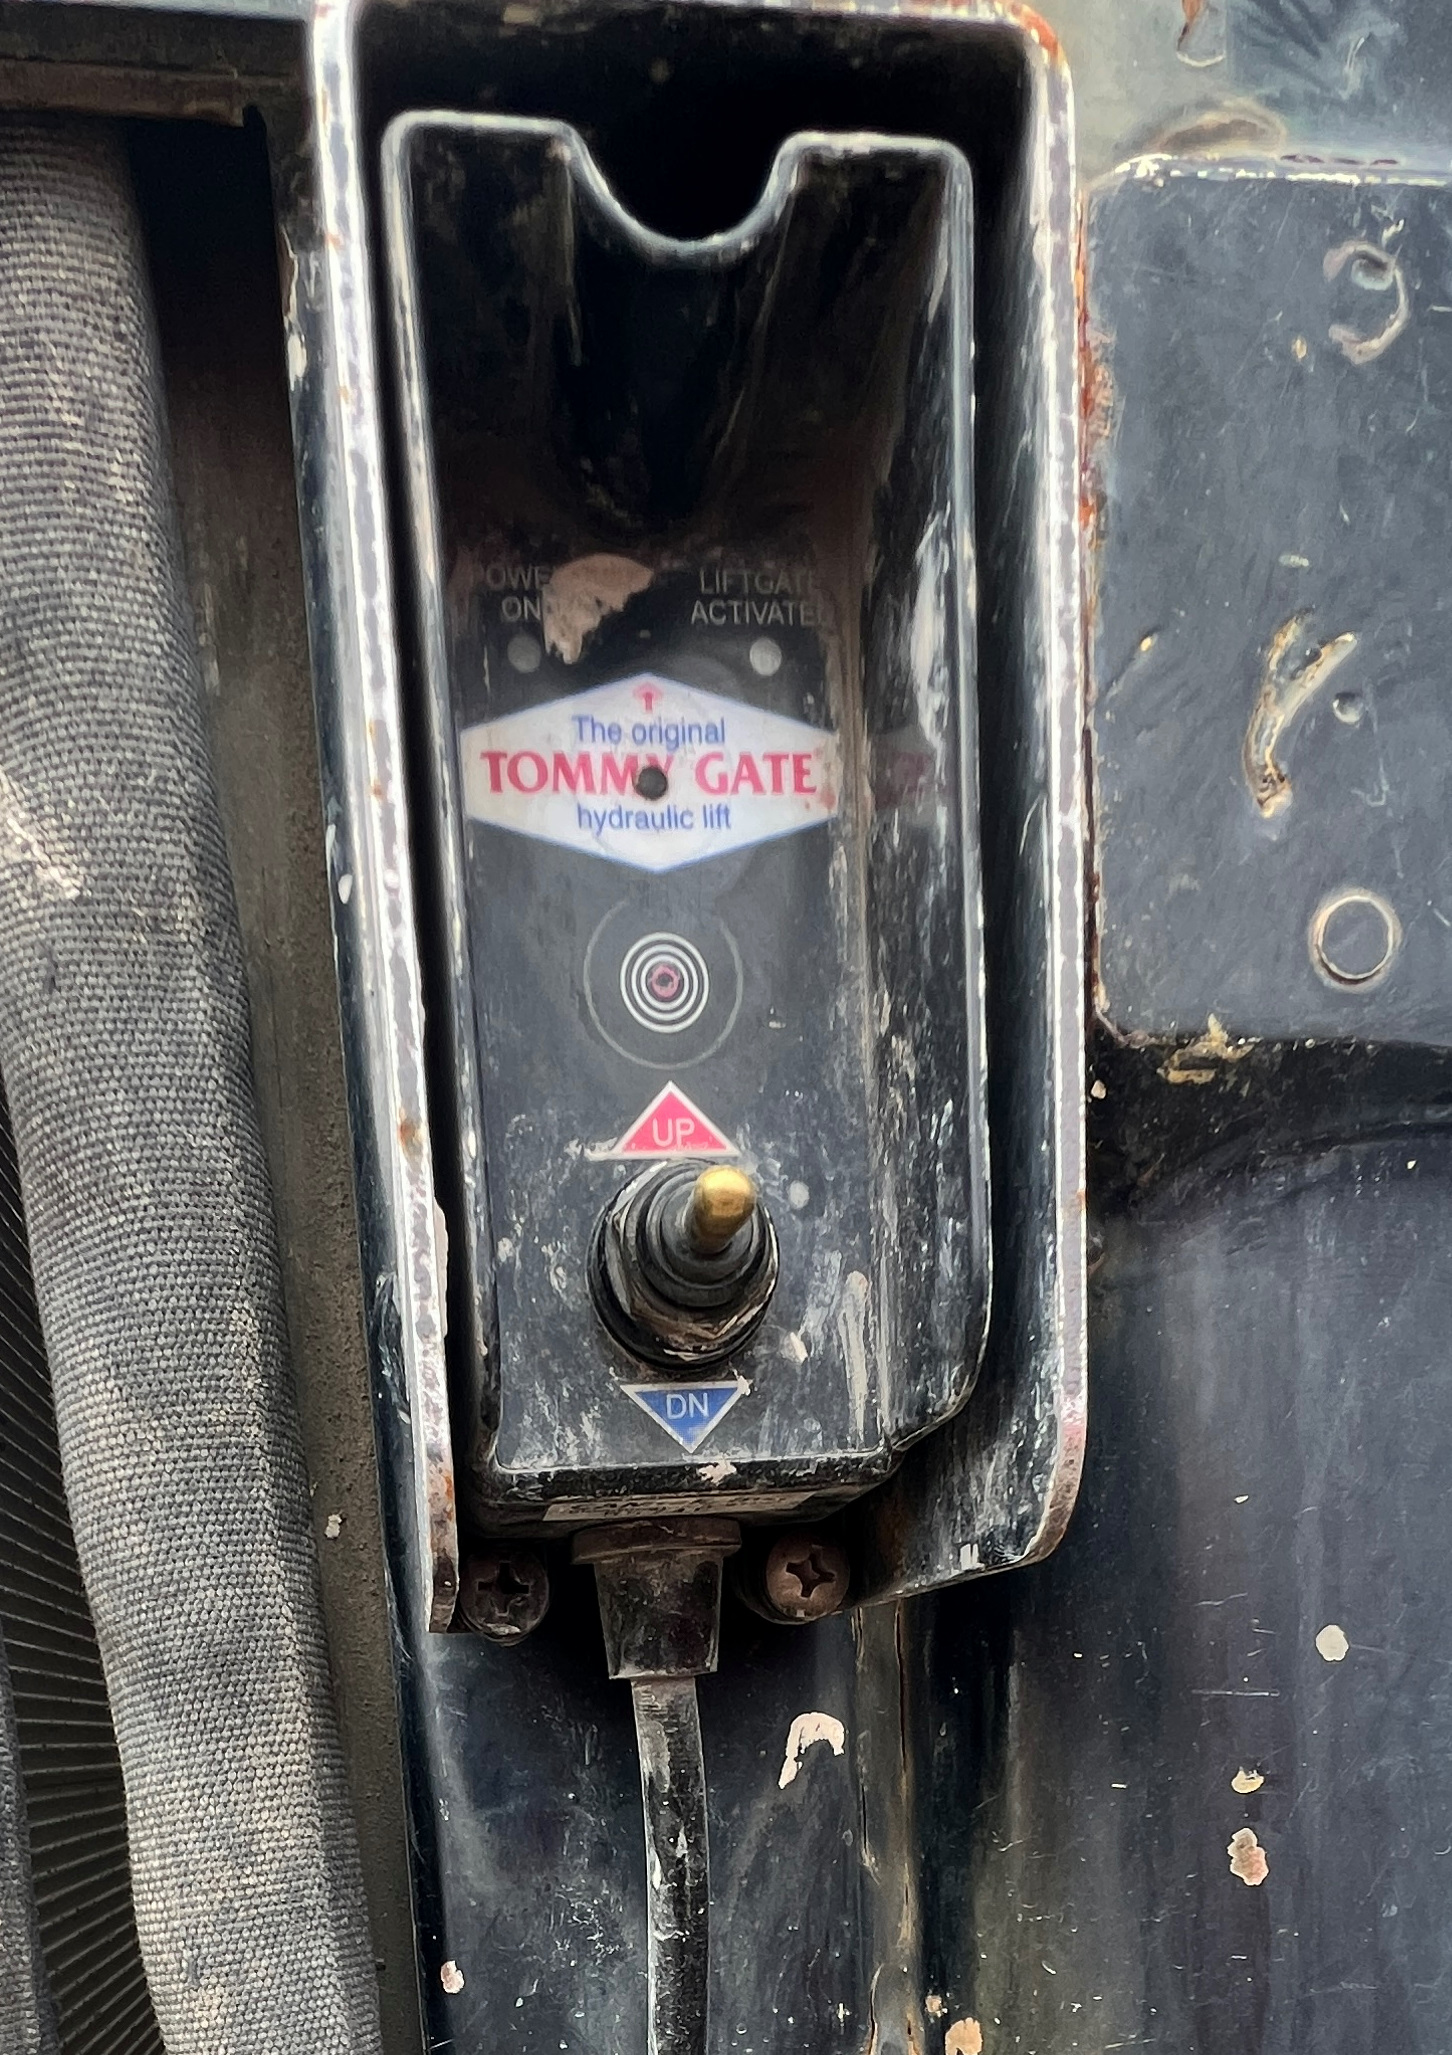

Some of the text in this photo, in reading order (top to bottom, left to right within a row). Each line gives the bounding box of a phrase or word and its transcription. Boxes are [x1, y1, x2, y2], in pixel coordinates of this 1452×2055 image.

[475, 563, 553, 591] OWE
[501, 596, 542, 622] ON
[571, 715, 726, 751] The original
[694, 752, 818, 796] GATE
[576, 803, 732, 834] hydraulic lift
[652, 1117, 696, 1148] UP
[665, 1392, 710, 1420] DN
